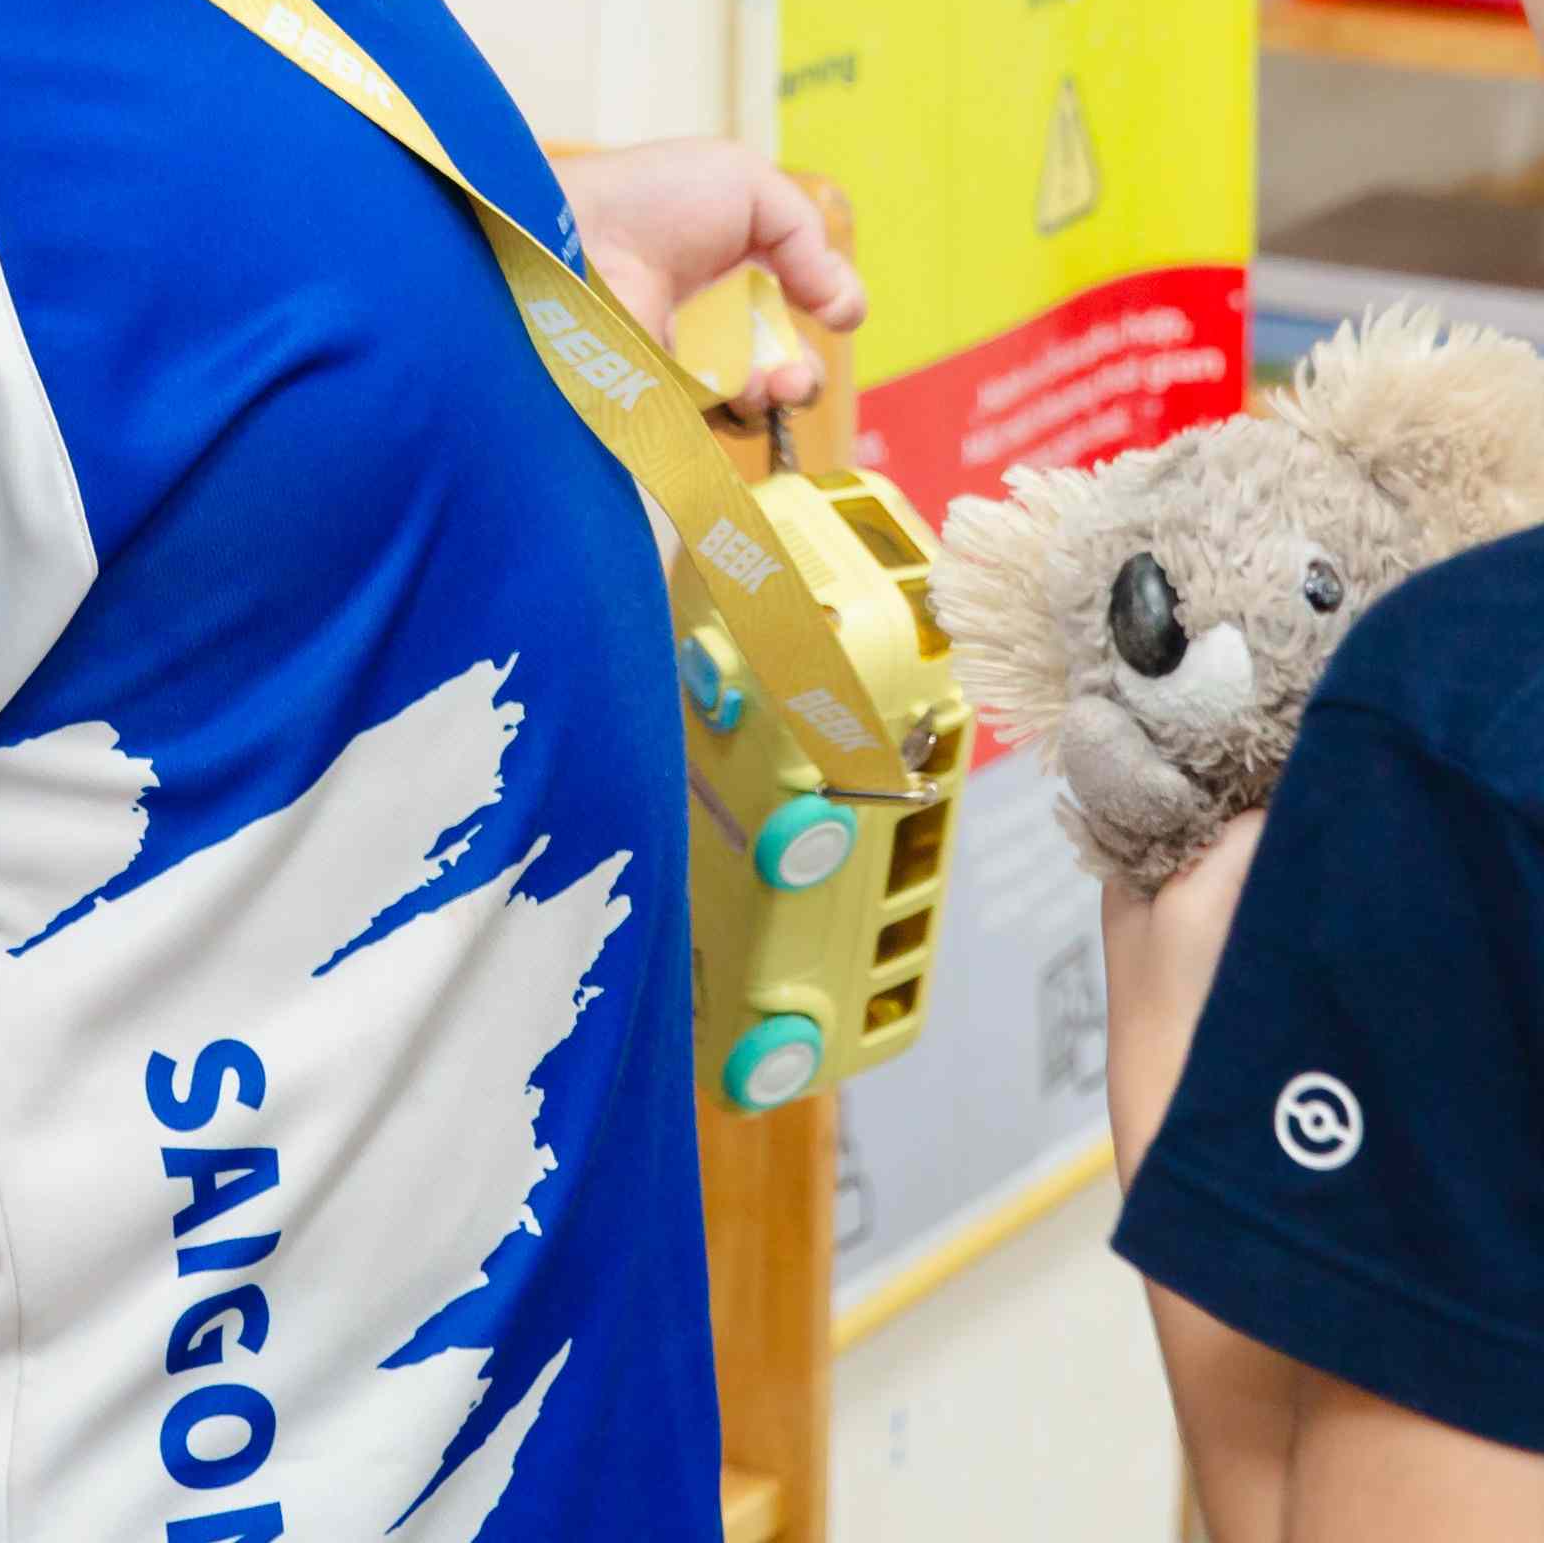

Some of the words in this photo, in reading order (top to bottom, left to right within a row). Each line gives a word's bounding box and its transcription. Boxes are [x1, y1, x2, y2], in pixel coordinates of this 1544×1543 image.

[263, 3, 394, 109] BEBK
[527, 298, 661, 413] BEBK
[697, 517, 785, 596] BEBK
[785, 688, 883, 753] BEBK
